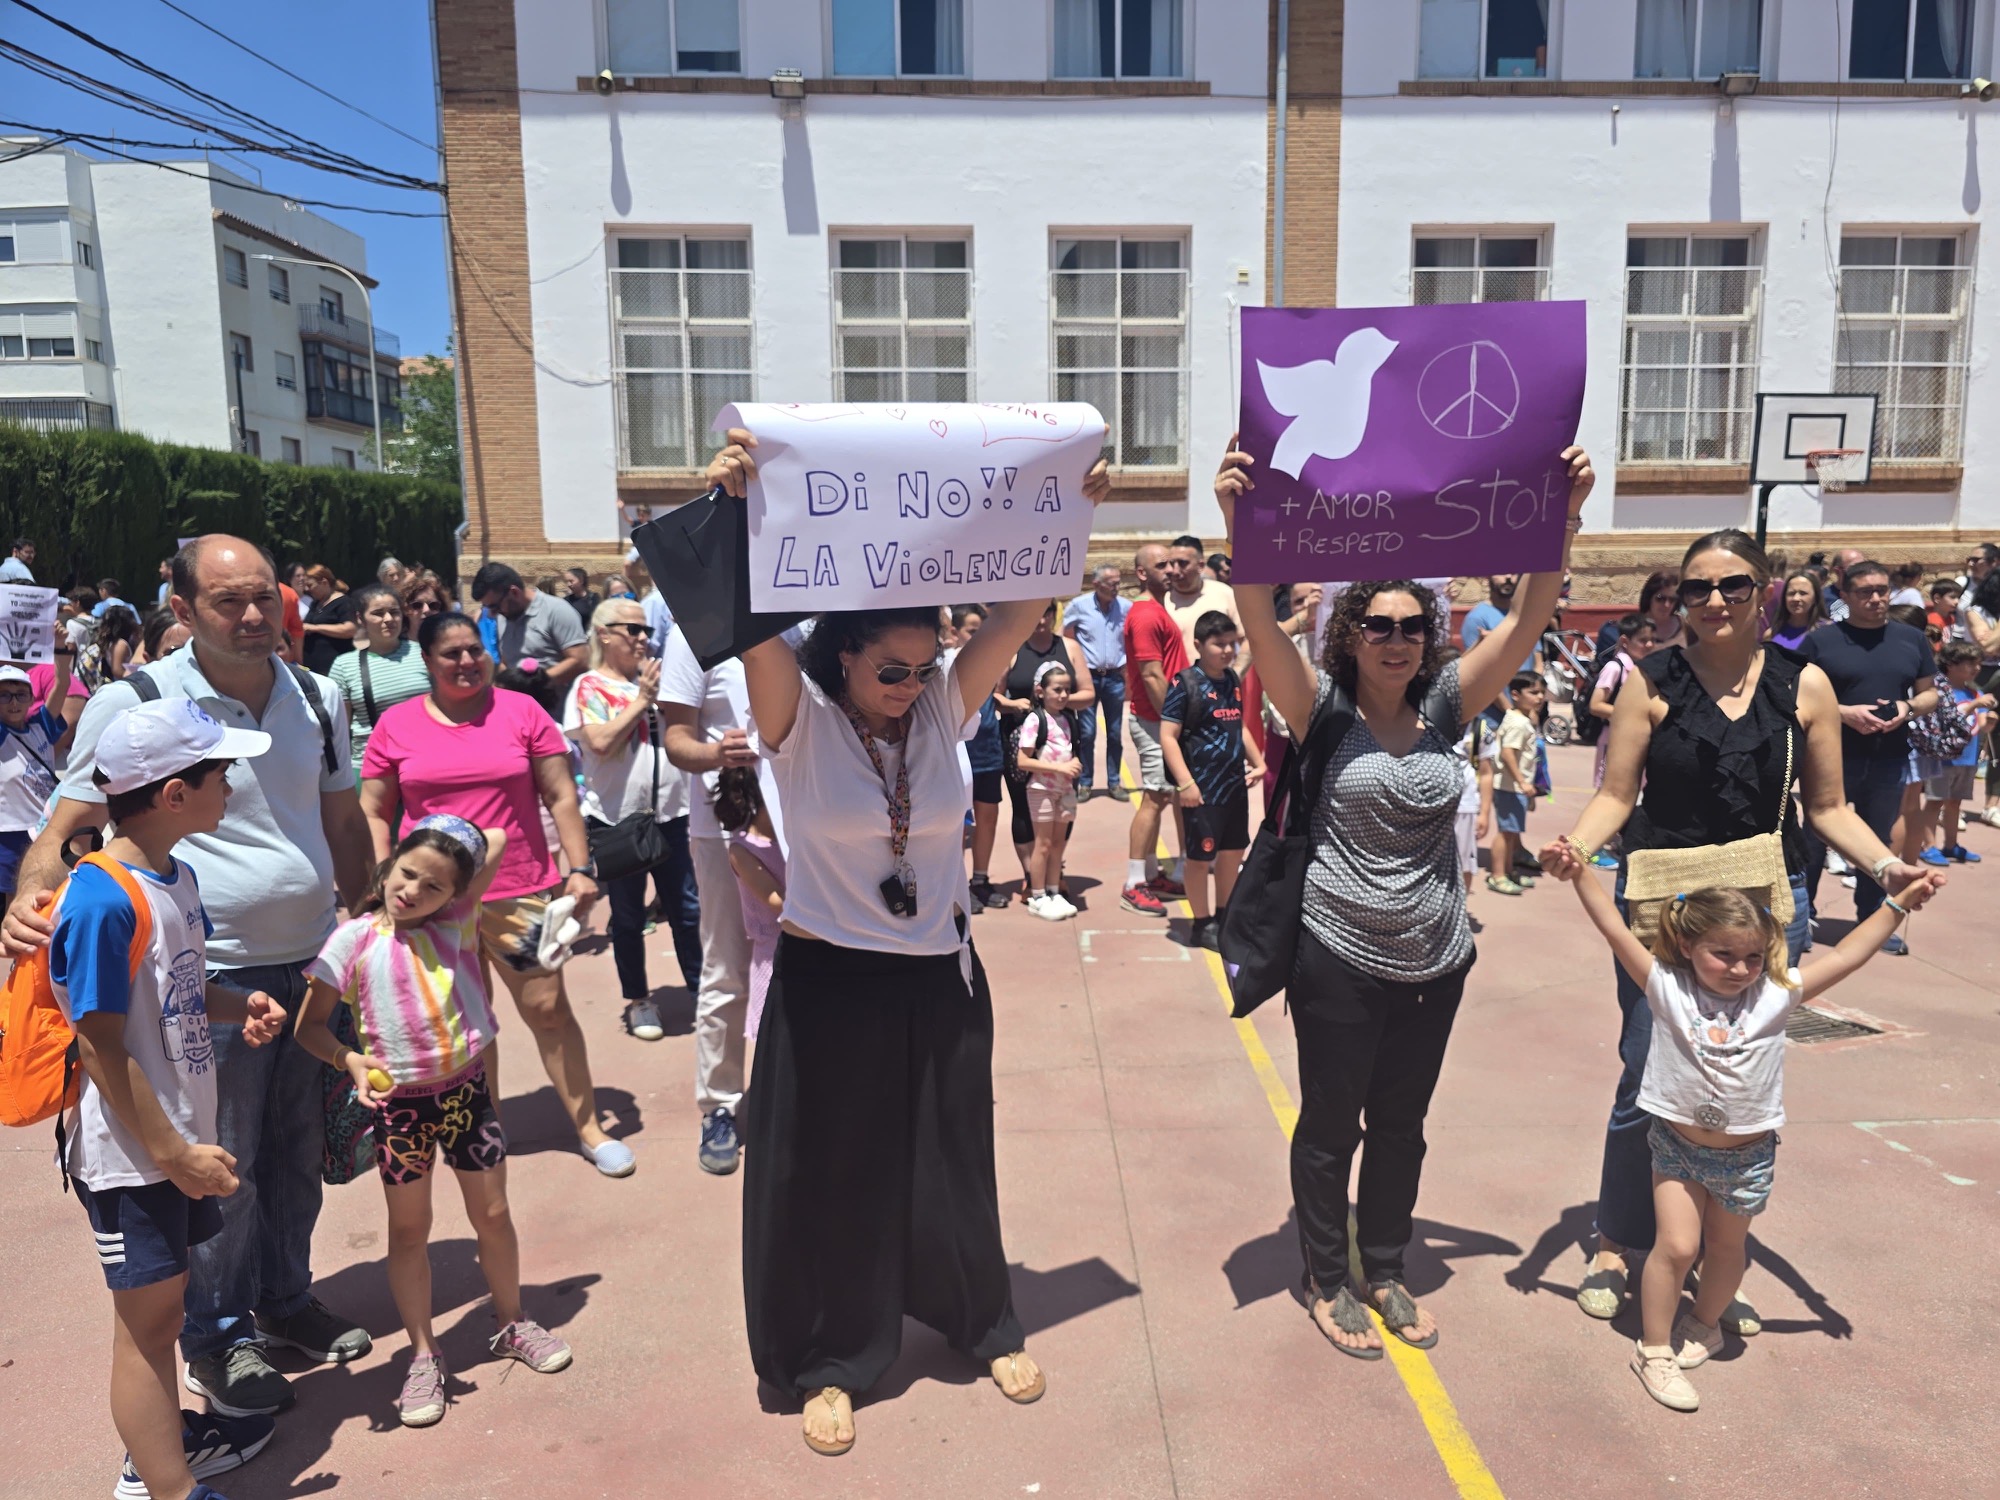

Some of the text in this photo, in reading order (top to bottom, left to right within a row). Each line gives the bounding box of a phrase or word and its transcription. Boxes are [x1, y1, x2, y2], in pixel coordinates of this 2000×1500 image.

[898, 466, 1018, 519] NO!!
[1034, 475, 1062, 513] A
[1307, 488, 1395, 520] AMOR
[1297, 528, 1404, 554] RESPETO
[773, 536, 839, 589] LA
[188, 1056, 213, 1075] ROND
